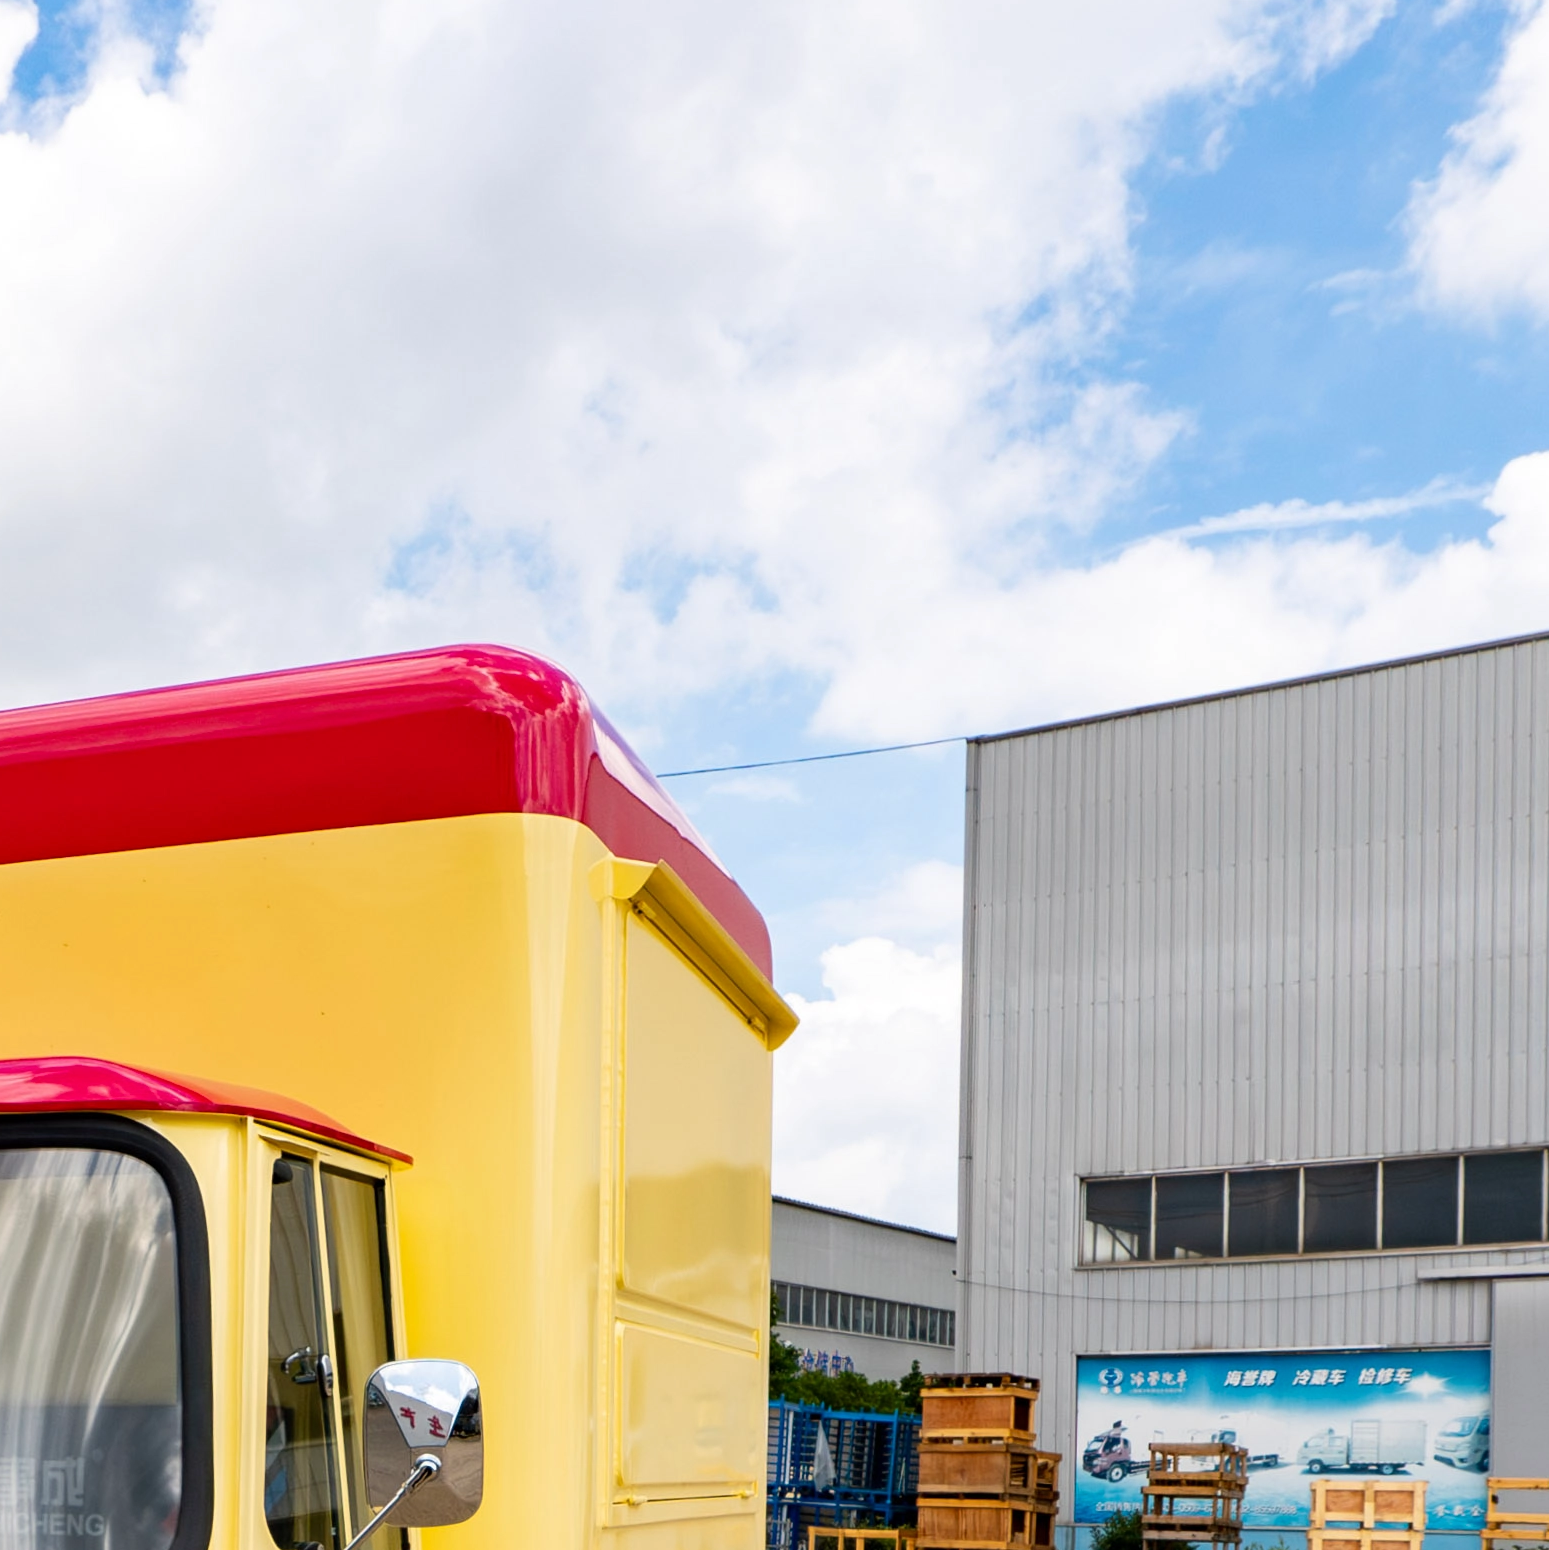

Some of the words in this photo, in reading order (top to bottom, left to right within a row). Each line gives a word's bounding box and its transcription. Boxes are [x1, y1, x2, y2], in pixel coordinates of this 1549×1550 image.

[1224, 1370, 1277, 1387] 海誉牌
[1292, 1369, 1347, 1386] 冷藏车
